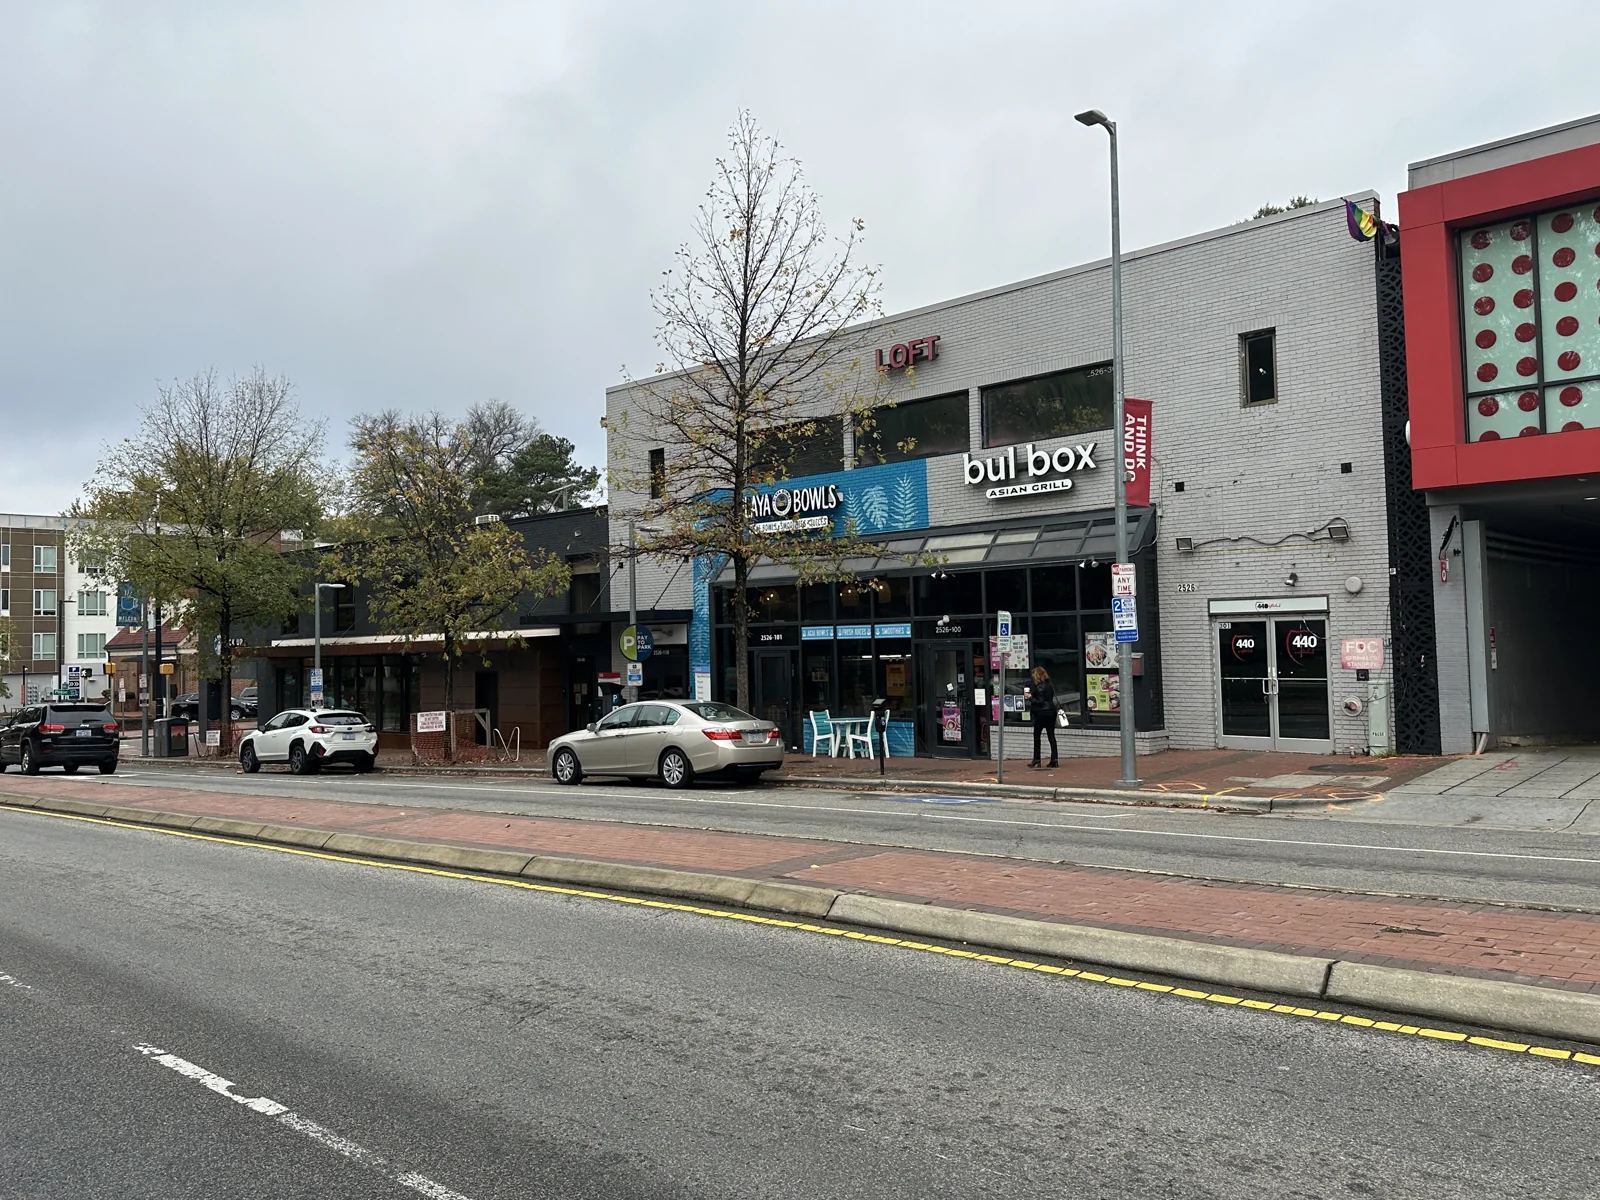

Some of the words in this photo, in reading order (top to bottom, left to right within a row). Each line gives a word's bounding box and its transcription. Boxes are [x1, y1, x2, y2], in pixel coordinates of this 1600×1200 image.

[875, 335, 940, 372] LOFT
[1125, 413, 1135, 453] AND
[1136, 415, 1147, 470] THINK
[963, 446, 1015, 485] bul
[1026, 443, 1097, 476] box
[990, 486, 1027, 497] ASIAN
[1032, 481, 1069, 491] GRILL
[793, 485, 837, 513] BOWLS
[1178, 584, 1196, 592] 2526
[1114, 600, 1121, 611] 2
[935, 626, 962, 634] 2526-100
[623, 635, 635, 650] P
[1236, 638, 1255, 648] 440
[1292, 635, 1317, 648] 440
[1345, 641, 1379, 653] FDC
[612, 694, 618, 702] P
